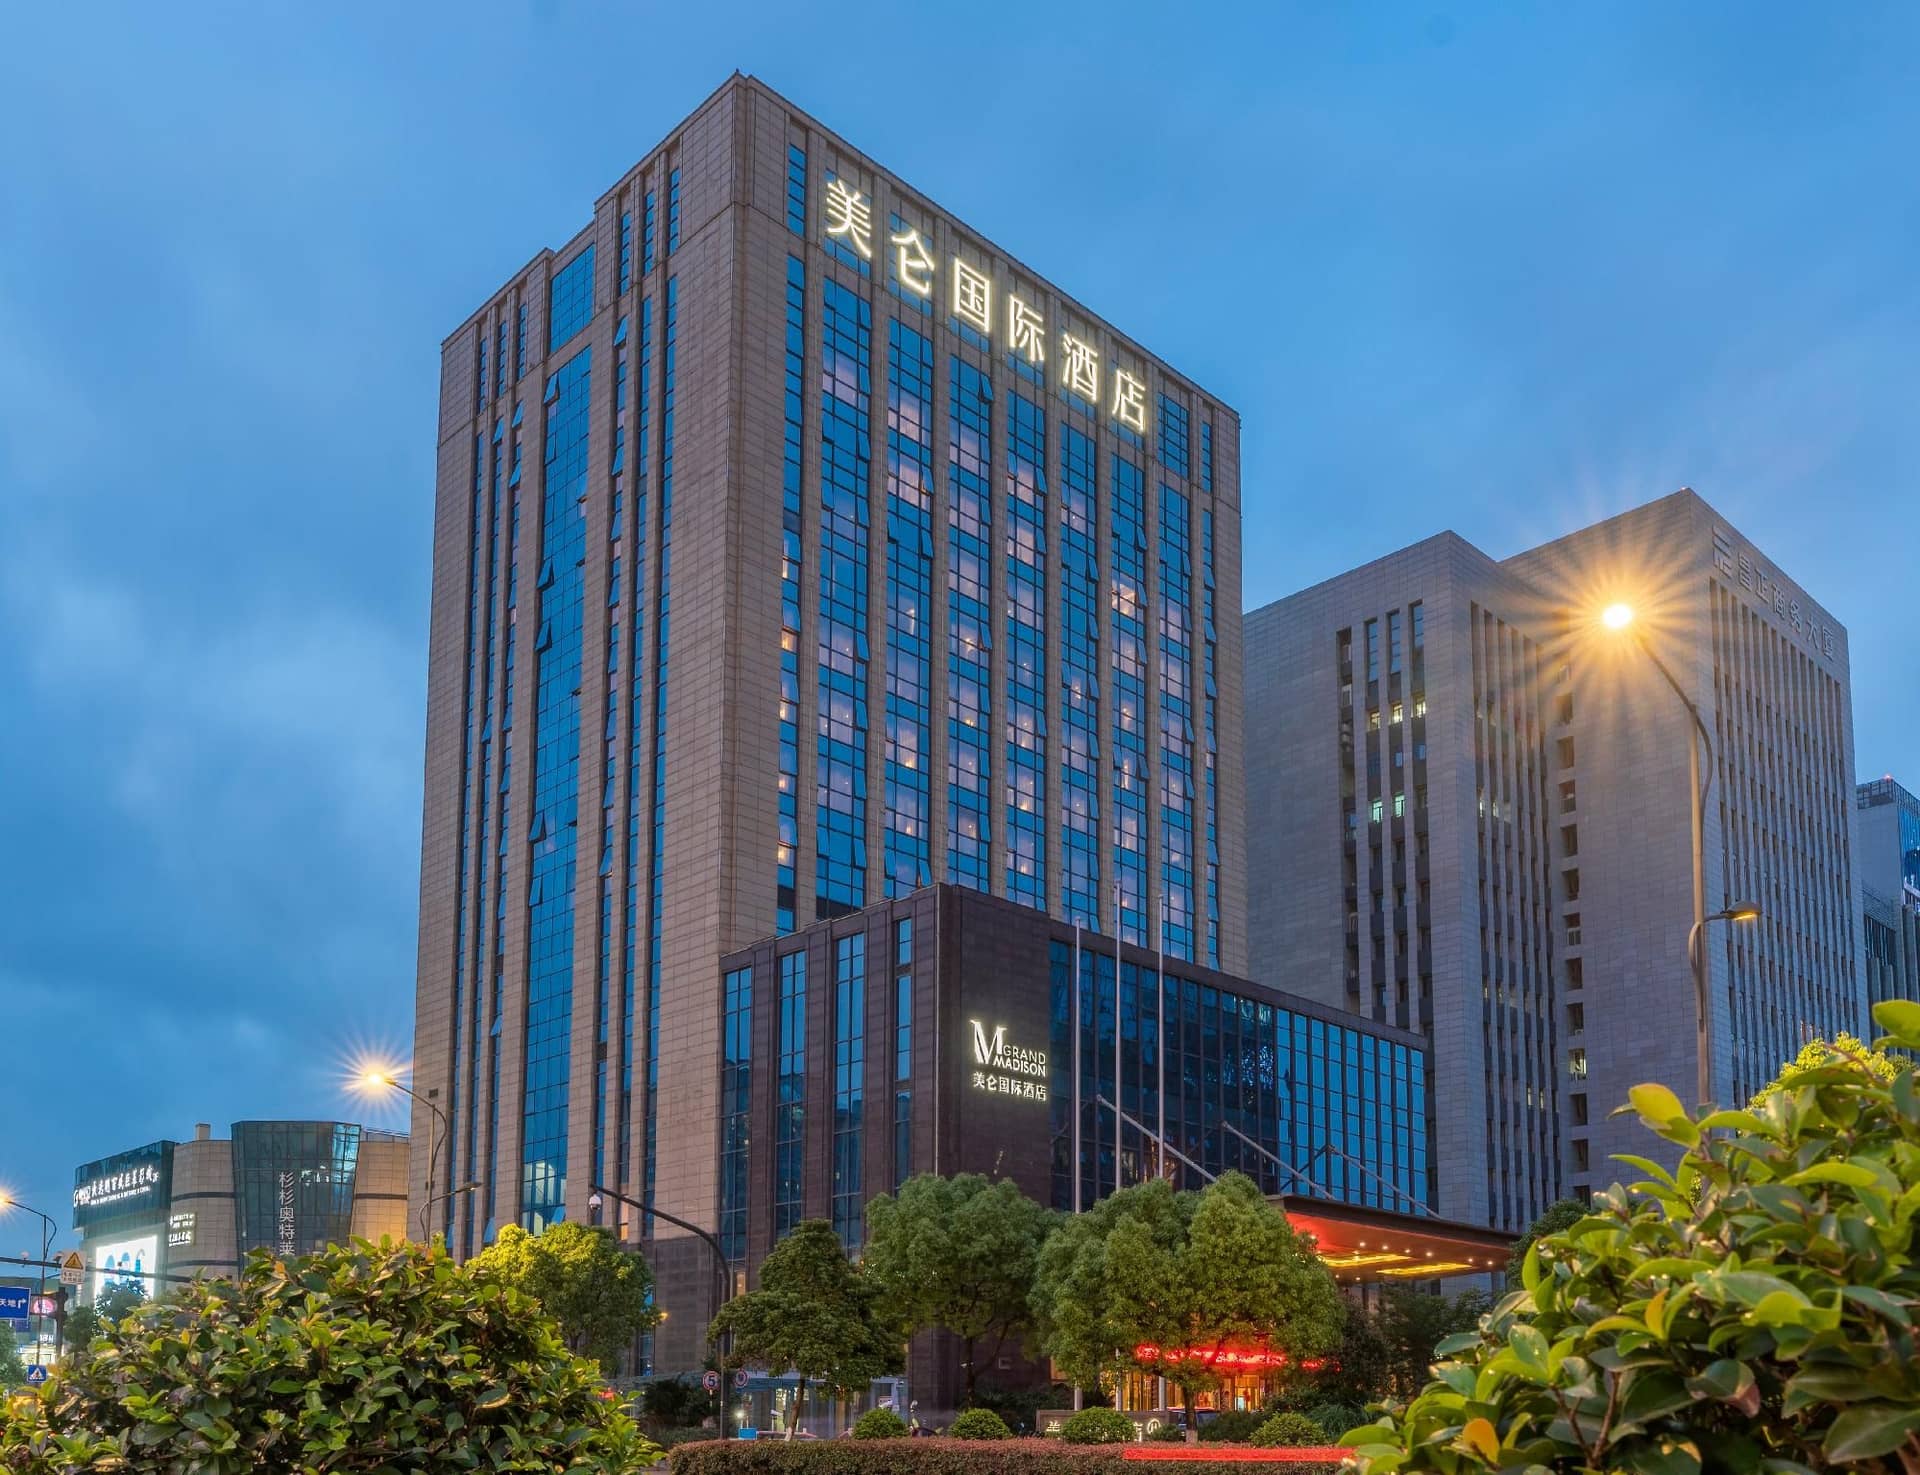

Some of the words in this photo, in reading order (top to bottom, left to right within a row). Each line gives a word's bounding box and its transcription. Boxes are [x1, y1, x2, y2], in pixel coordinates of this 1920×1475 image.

[826, 180, 1146, 432] 美仑国际酒店
[1003, 1044, 1046, 1065] GRAND
[993, 1055, 1046, 1077] MADISON
[972, 1071, 1047, 1102] 美仑国际酒店
[708, 1375, 716, 1387] 5
